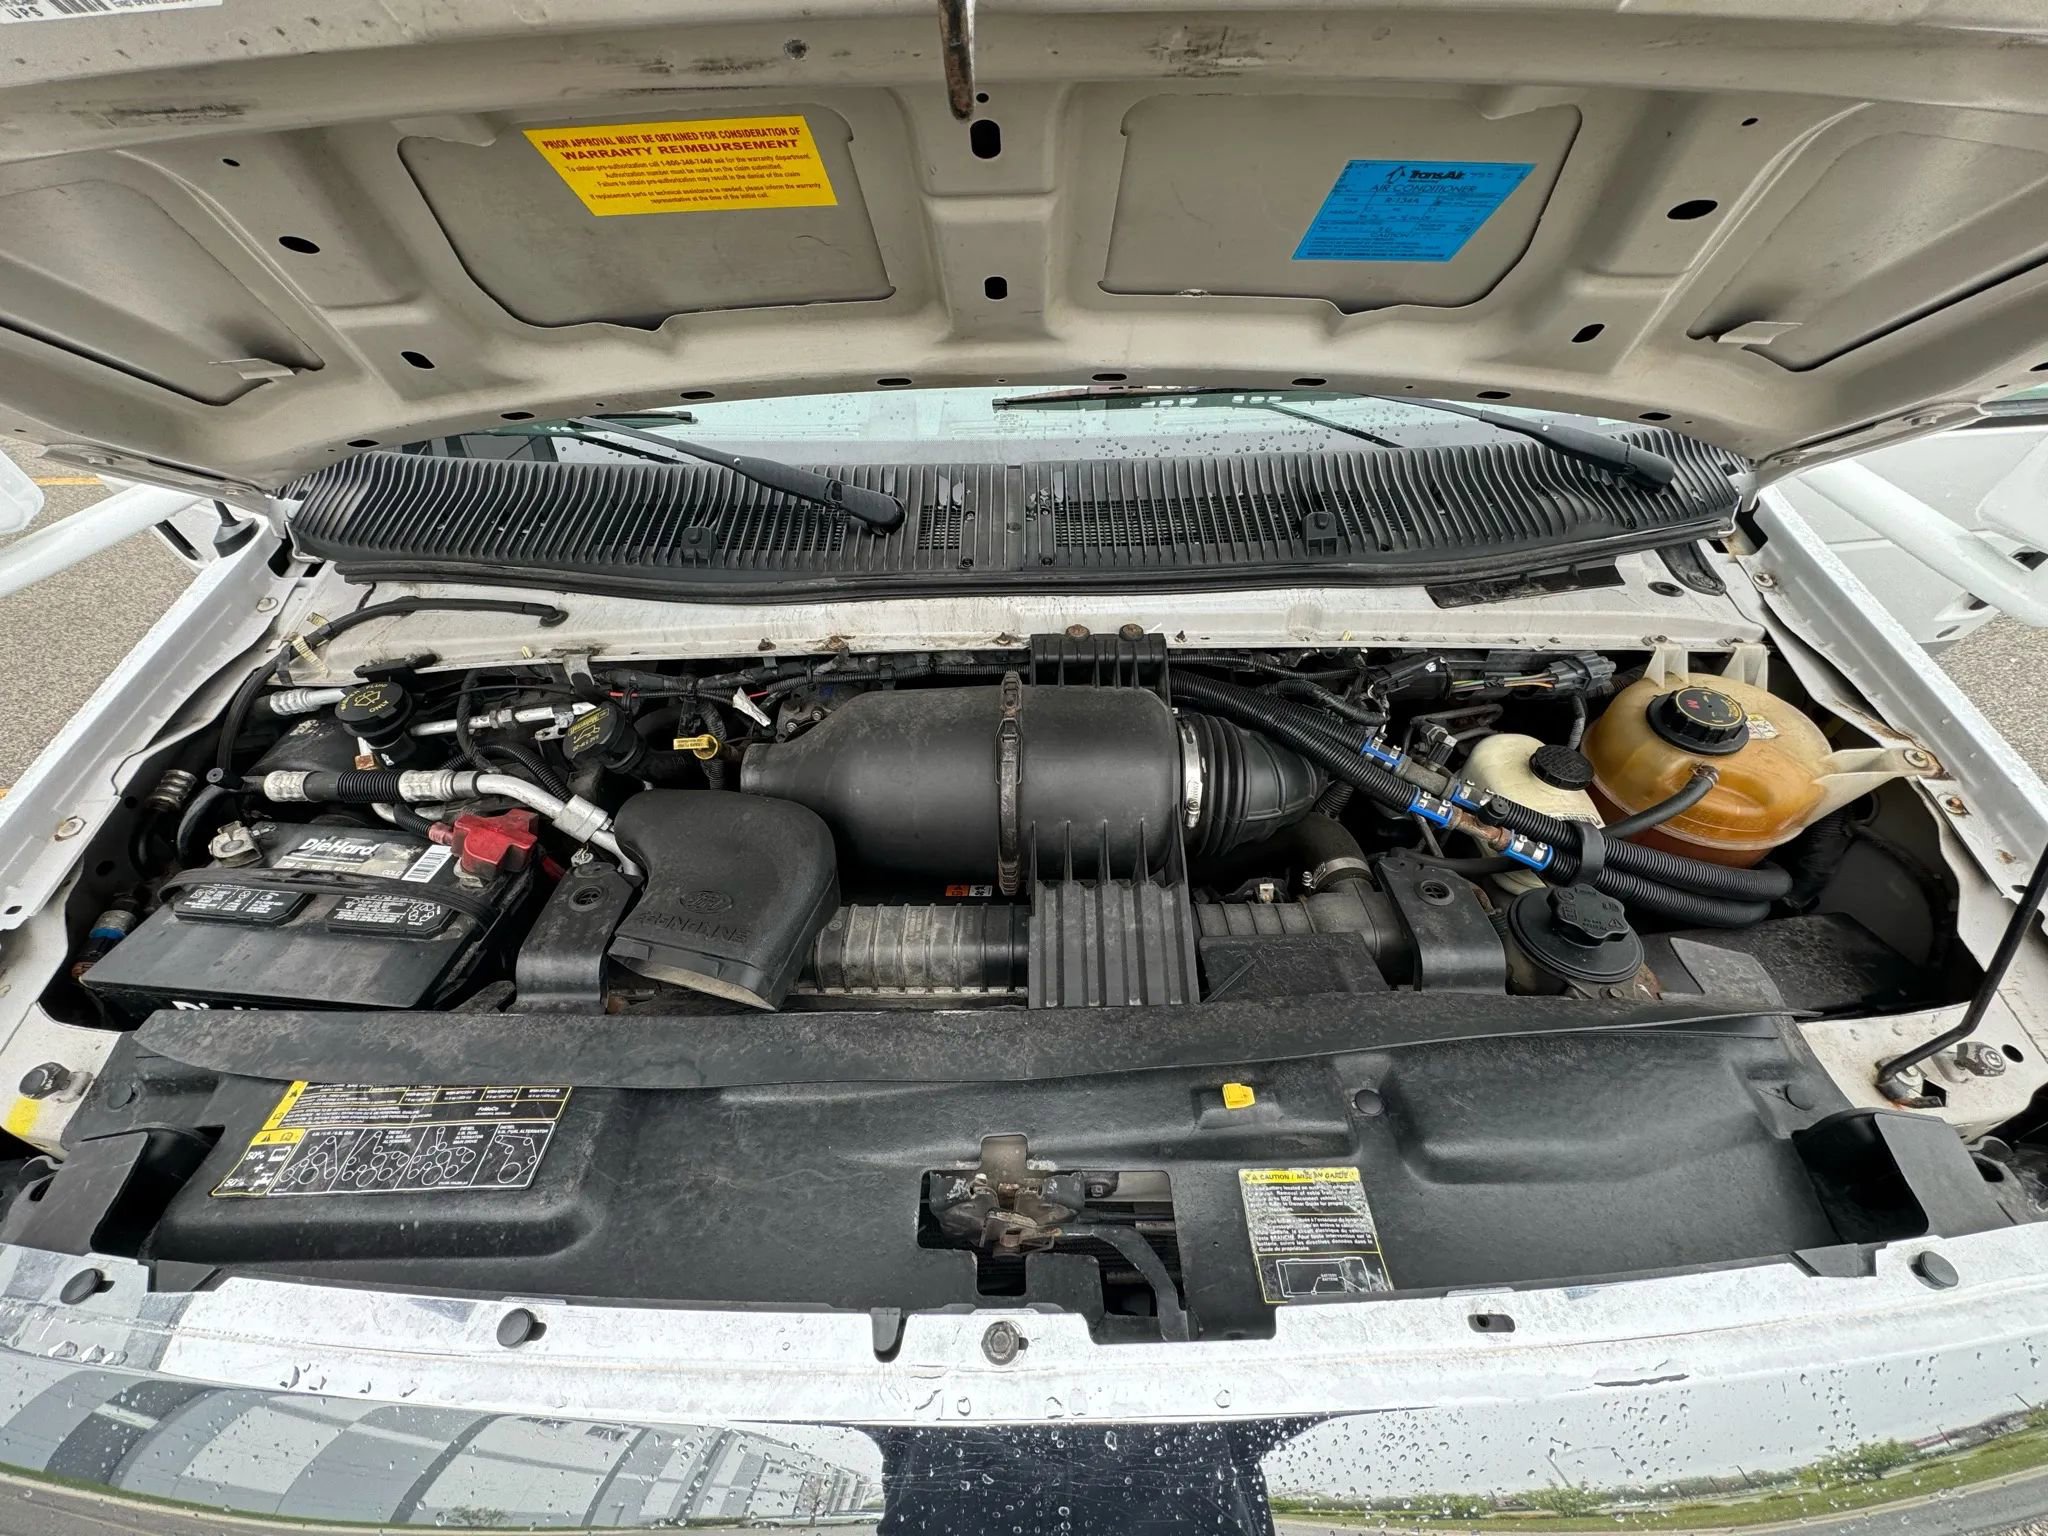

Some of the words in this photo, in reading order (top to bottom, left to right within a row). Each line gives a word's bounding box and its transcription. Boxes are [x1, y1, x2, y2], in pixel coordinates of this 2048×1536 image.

[5, 6, 44, 19] UPS
[542, 139, 571, 150] PRIOR
[570, 137, 616, 148] APPROVAL
[615, 135, 641, 145] MUST
[641, 134, 655, 143] BE
[655, 131, 700, 143] OBTAINED
[700, 130, 719, 140] FOR
[719, 127, 788, 139] CONSIDERATION
[790, 127, 801, 136] OF
[560, 147, 653, 160] WARRANTY
[657, 139, 798, 154] REIMBURSEMENT
[1410, 170, 1466, 180] TransAir
[1371, 184, 1391, 193] AIR
[1393, 185, 1478, 193] CONDITIONER
[369, 699, 389, 713] ONLY
[299, 837, 380, 856] DieHard
[380, 869, 403, 877] GOLD
[245, 1150, 266, 1161] 50%
[223, 1178, 245, 1187] 50%
